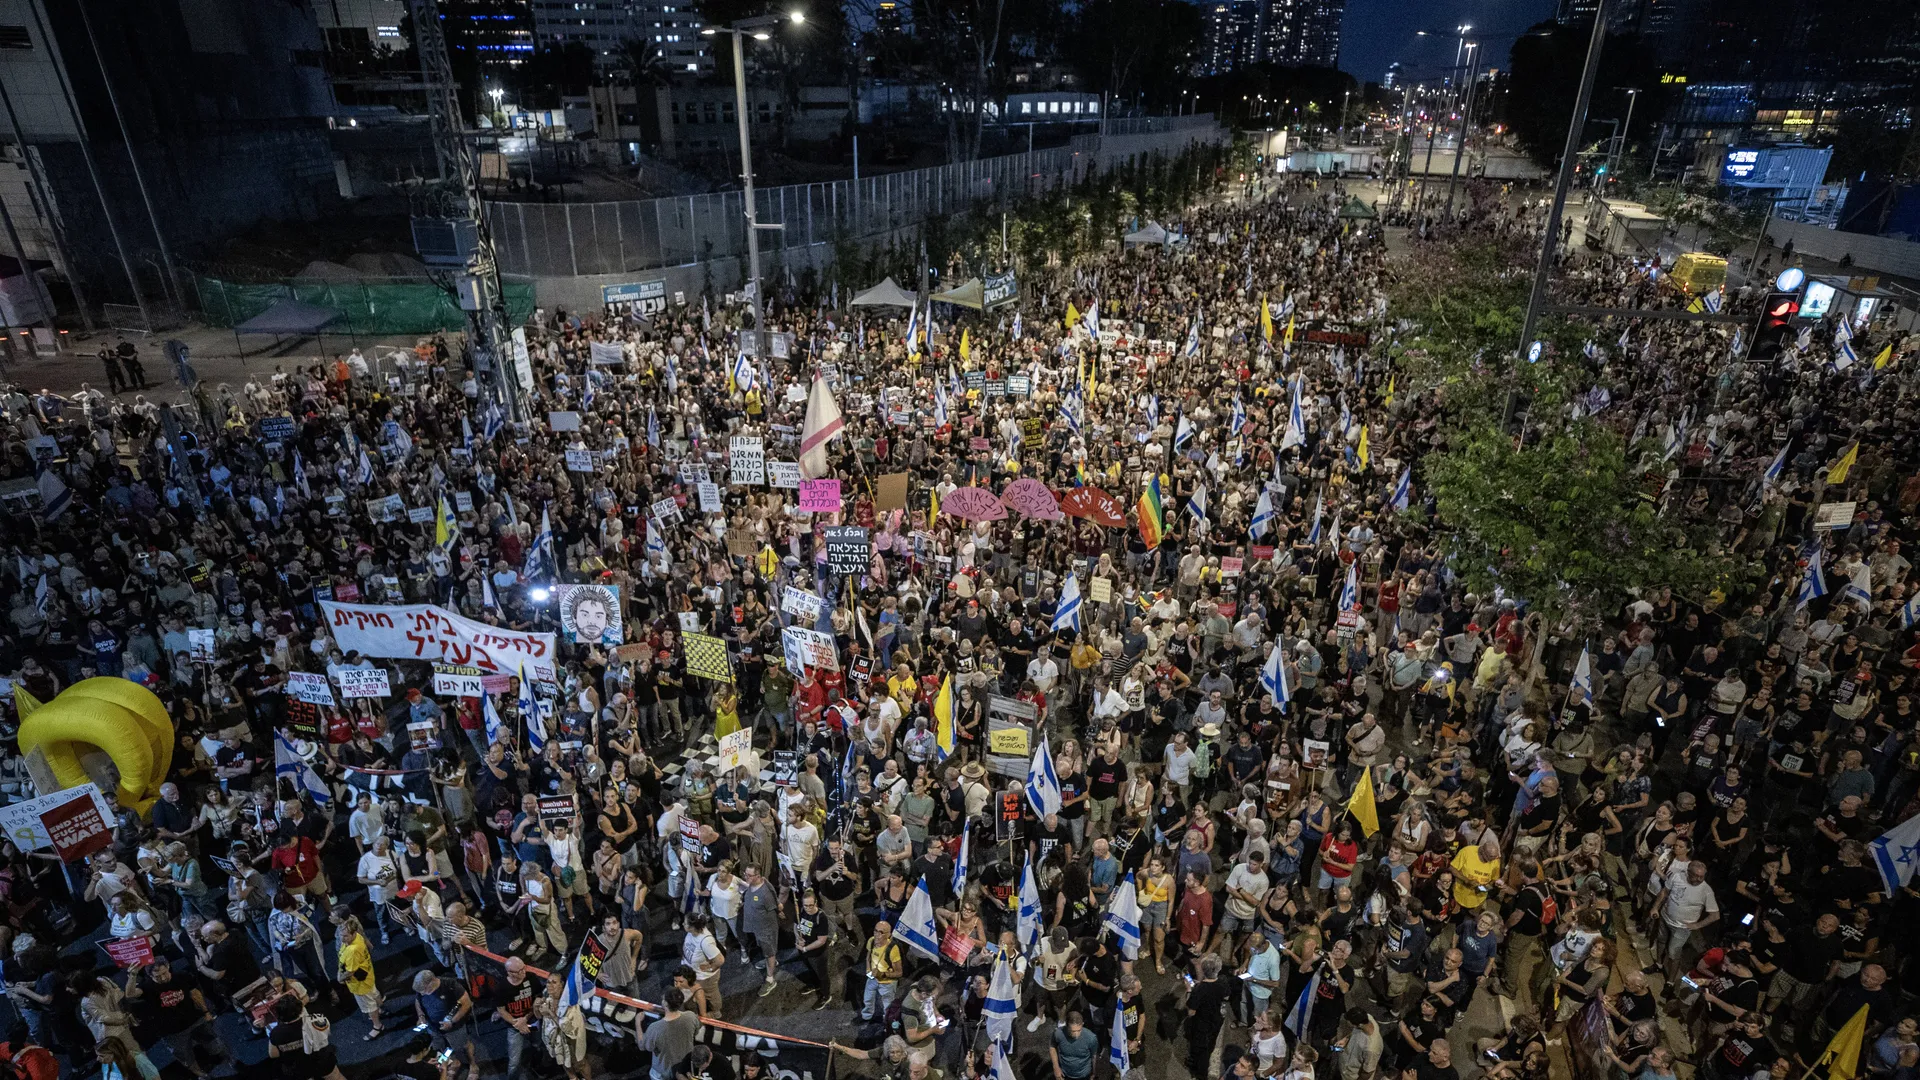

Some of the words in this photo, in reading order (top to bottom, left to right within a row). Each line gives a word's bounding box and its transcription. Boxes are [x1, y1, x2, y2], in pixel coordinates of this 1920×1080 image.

[1322, 321, 1352, 333] Son
[731, 449, 761, 459] ממשלה
[733, 460, 762, 469] בוגדת
[731, 470, 762, 482] בעמה
[1006, 483, 1031, 502] שלום
[952, 492, 966, 507] את
[1098, 496, 1122, 520] עלה
[825, 529, 842, 538] זאת
[844, 527, 864, 538] ובכל
[830, 553, 869, 563] המדינה
[334, 608, 394, 630] חוקית
[405, 609, 457, 637] בלתי
[438, 680, 460, 692] זמן
[462, 681, 480, 692] אין
[49, 819, 73, 833] END
[70, 807, 97, 822] THIS
[55, 822, 105, 849] WAR
[118, 941, 131, 949] THE
[131, 950, 148, 958] THEM
